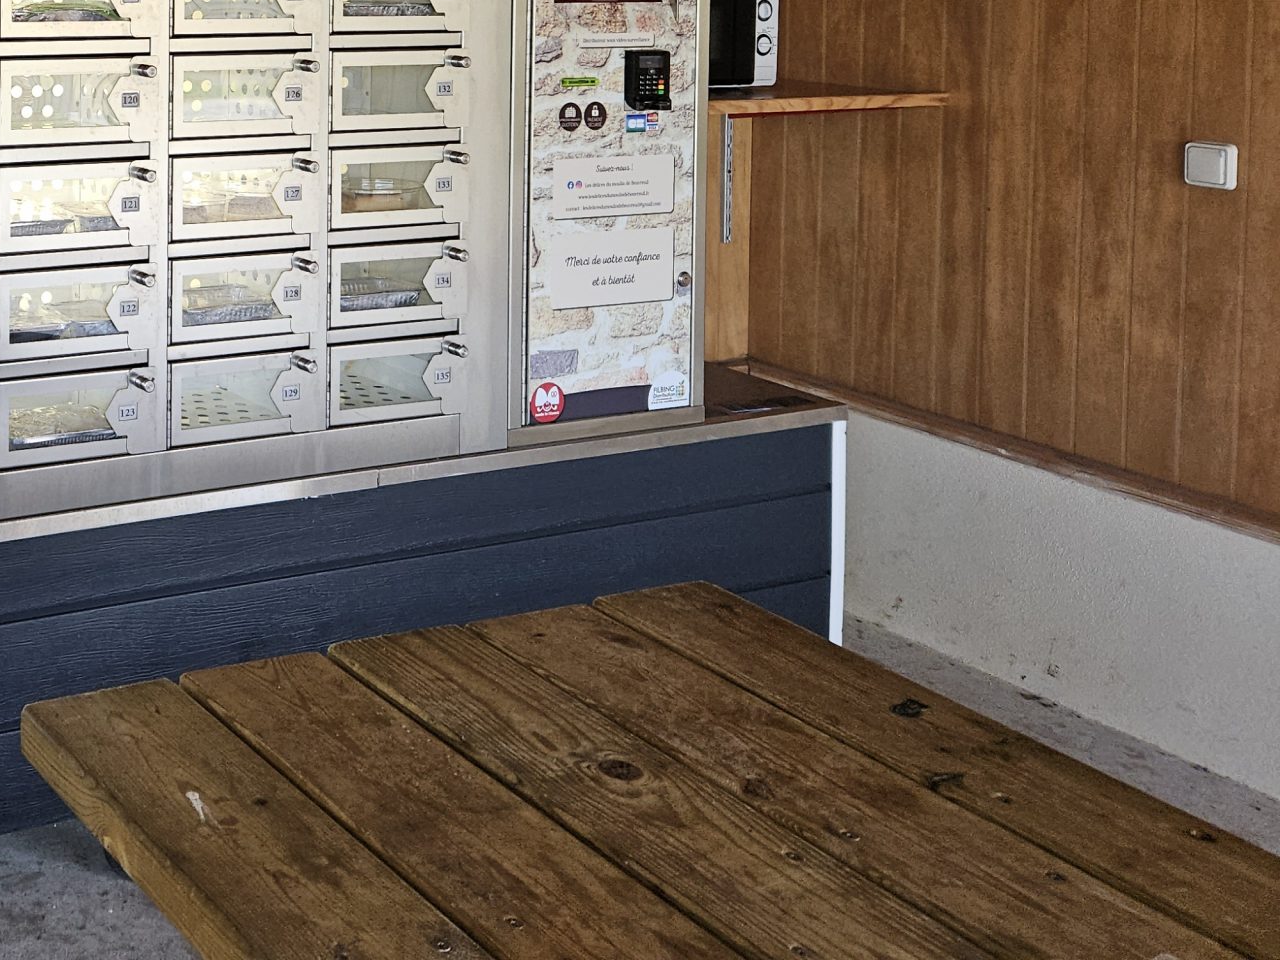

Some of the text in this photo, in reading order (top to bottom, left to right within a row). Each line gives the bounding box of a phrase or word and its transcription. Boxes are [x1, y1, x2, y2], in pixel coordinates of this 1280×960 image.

[437, 85, 451, 94] 132
[286, 90, 301, 99] 126
[123, 96, 139, 105] 120
[436, 180, 451, 189] 133
[285, 190, 300, 199] 127
[123, 200, 138, 209] 121
[565, 251, 661, 267] Merci de votre confiance
[436, 277, 450, 285] 134
[592, 273, 635, 286] et à bientôt
[284, 289, 299, 299] 128
[121, 304, 137, 313] 122
[435, 372, 450, 381] 135
[283, 389, 298, 398] 129
[120, 408, 136, 417] 123
